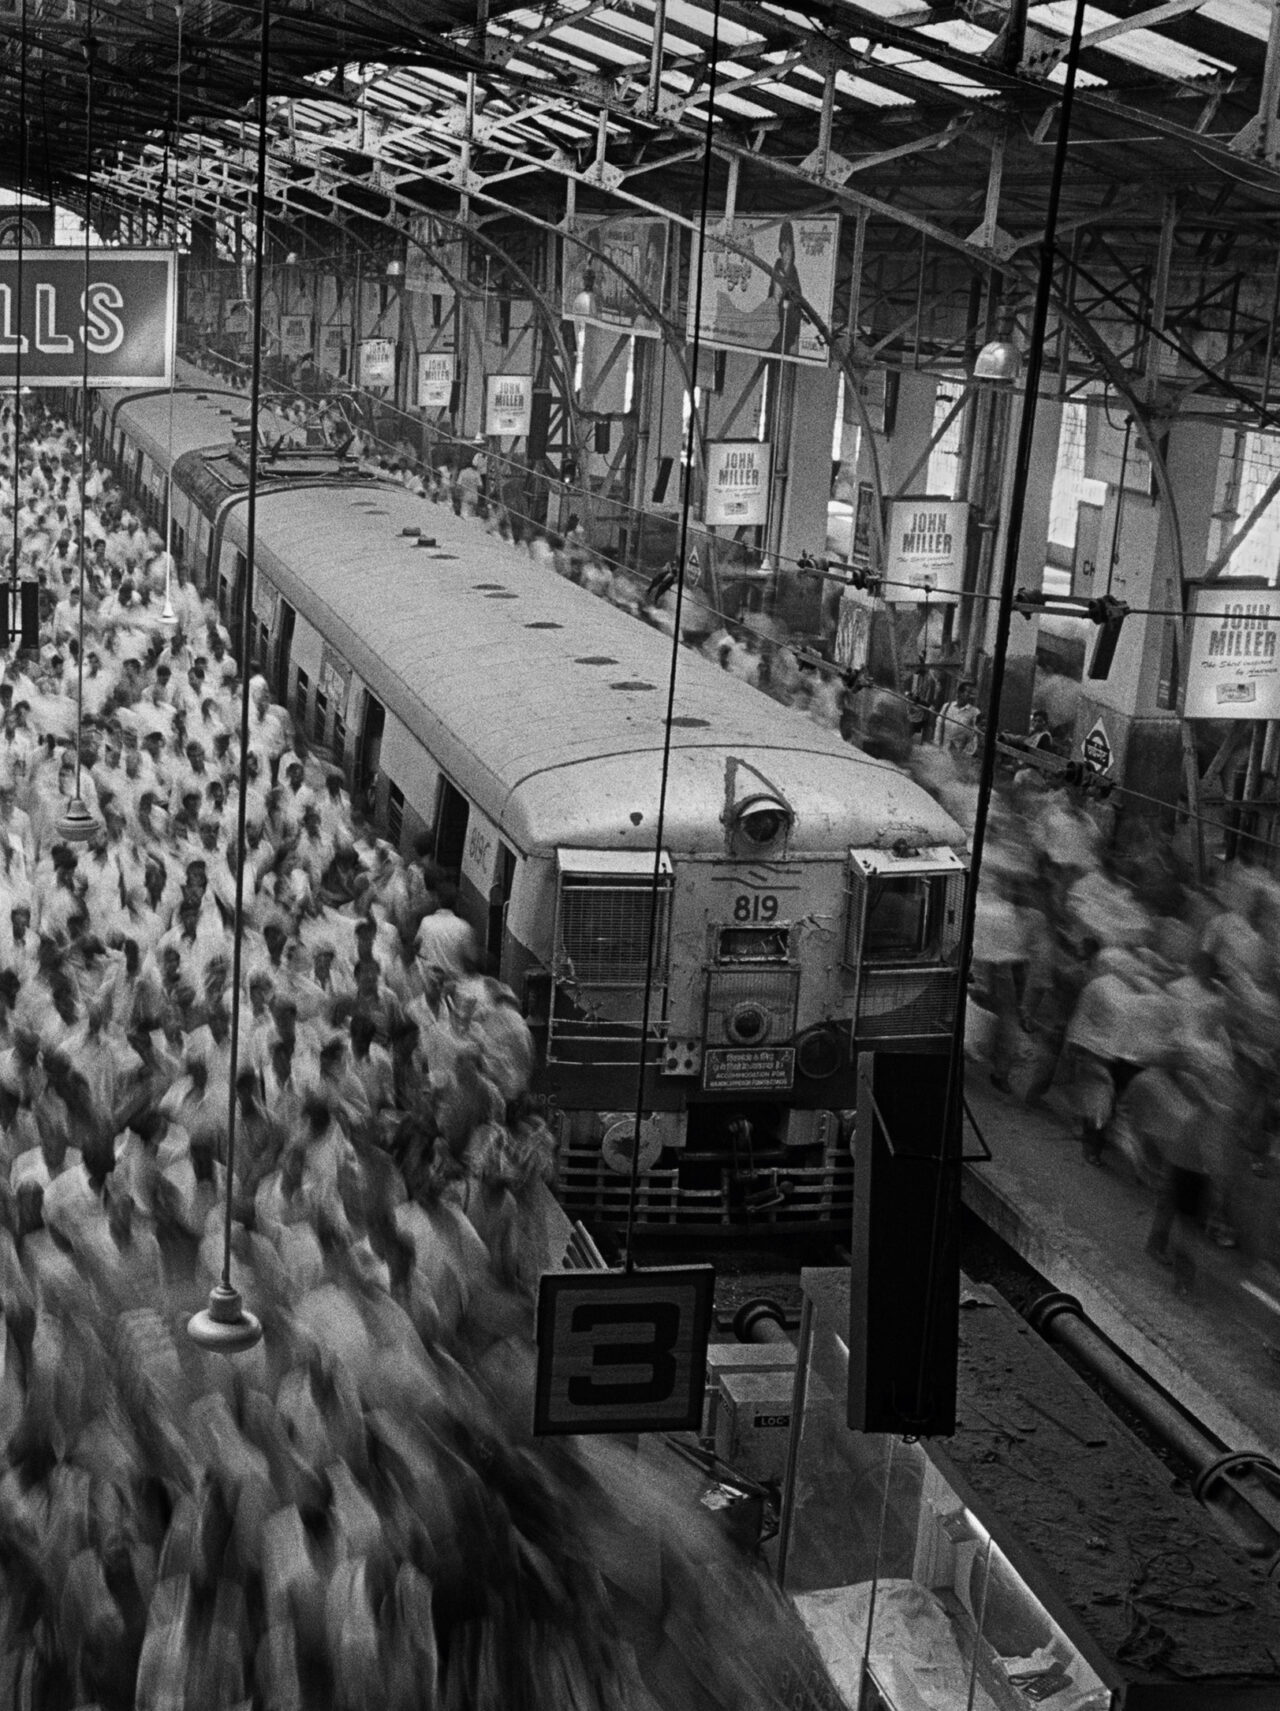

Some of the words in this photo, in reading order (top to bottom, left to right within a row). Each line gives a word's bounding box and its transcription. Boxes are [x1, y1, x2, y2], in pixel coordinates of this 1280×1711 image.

[499, 383, 521, 395] JOHN
[495, 395, 524, 407] MILLER
[725, 453, 755, 469] JOHN
[719, 469, 759, 485] MILLER
[911, 513, 948, 533] JOHN
[902, 533, 953, 553] MILLER
[1221, 603, 1271, 630] JOHN
[1208, 630, 1277, 656] MILLER
[734, 895, 779, 921] 819
[568, 1302, 680, 1406] 3
